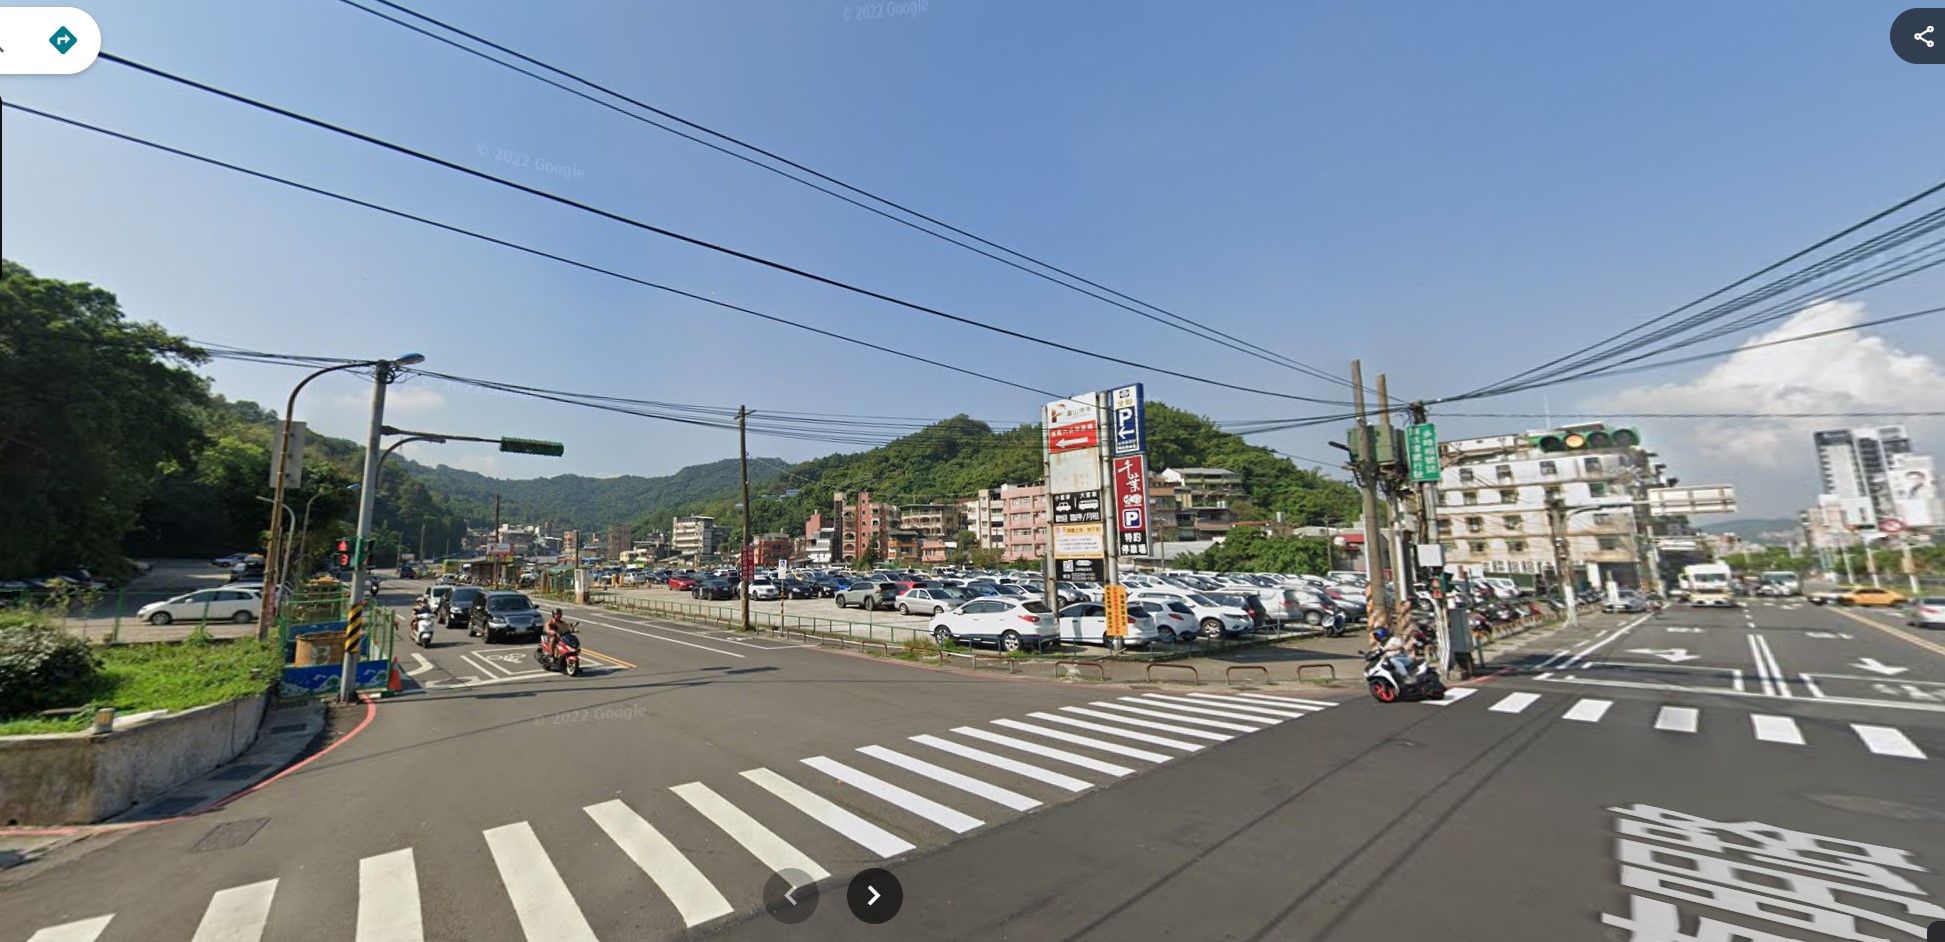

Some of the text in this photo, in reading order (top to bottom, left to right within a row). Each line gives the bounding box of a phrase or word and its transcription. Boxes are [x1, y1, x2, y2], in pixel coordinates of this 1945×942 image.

[1119, 407, 1133, 428] P
[1125, 511, 1139, 526] P
[340, 554, 349, 566] 3
